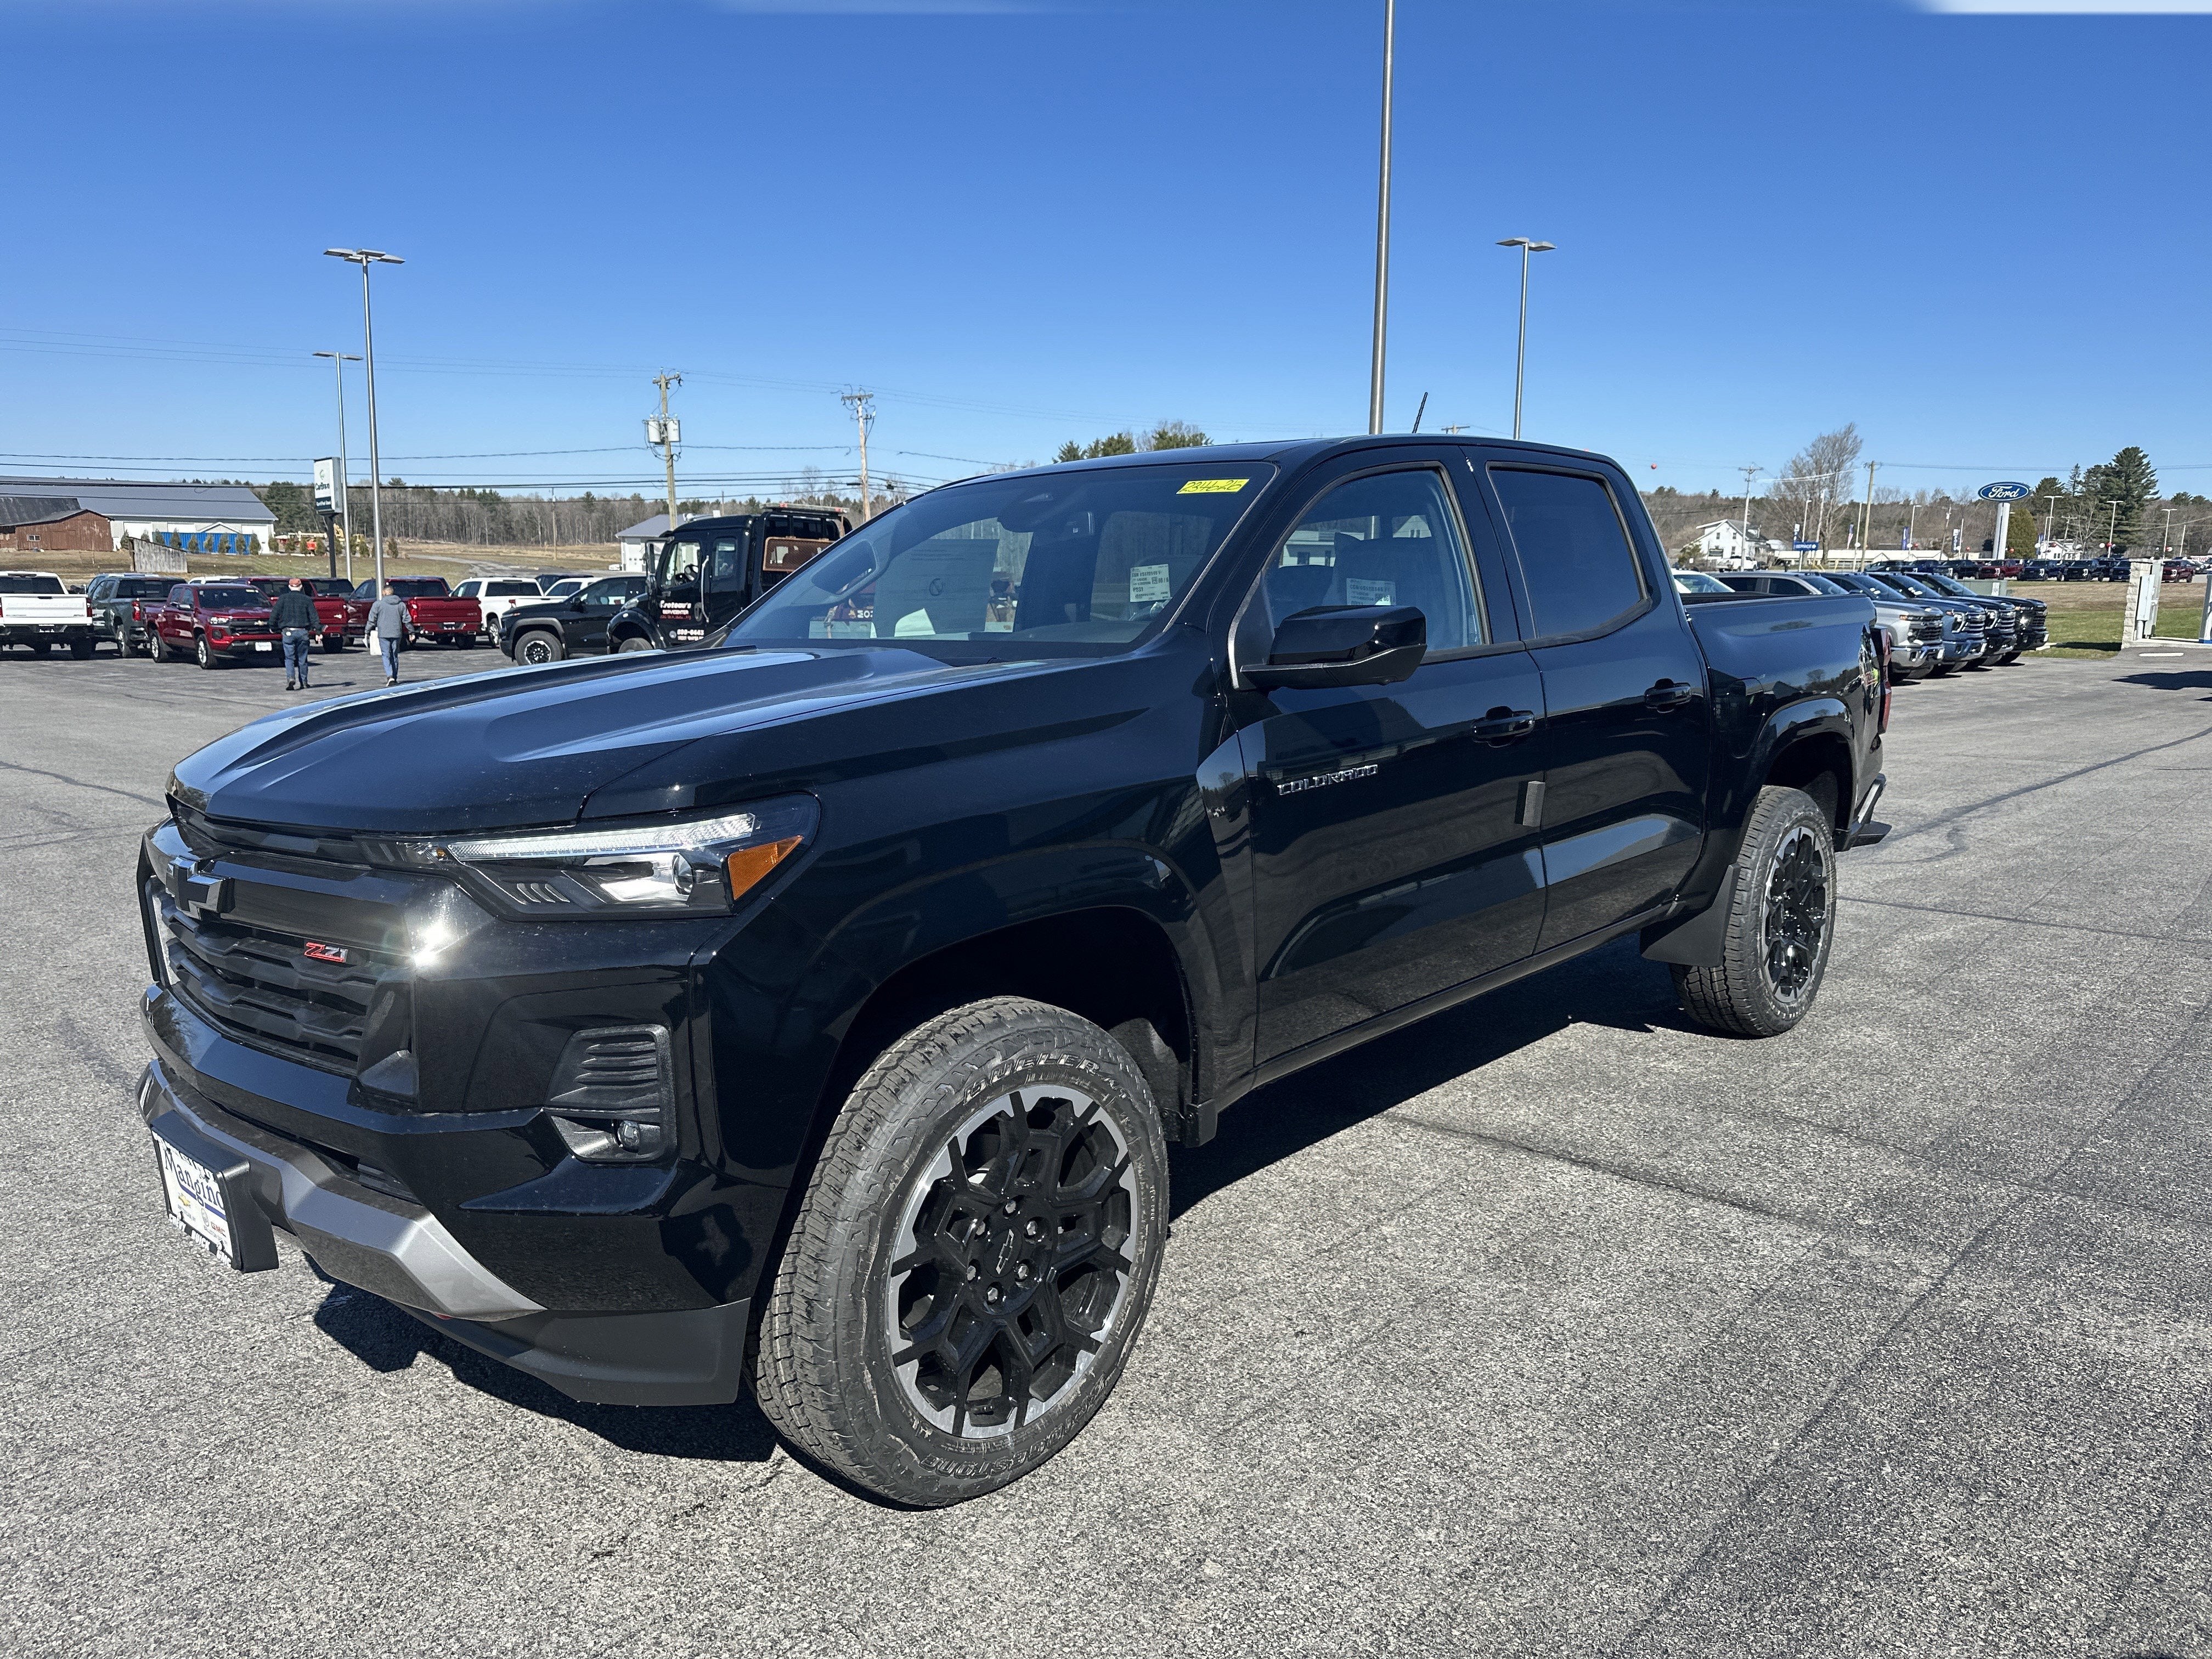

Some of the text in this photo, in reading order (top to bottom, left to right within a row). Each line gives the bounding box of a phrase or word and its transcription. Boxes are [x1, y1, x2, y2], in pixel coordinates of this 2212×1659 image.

[1988, 485, 2021, 498] Ford
[1277, 764, 1378, 795] COLORADO
[304, 942, 348, 963] Z71
[165, 1149, 224, 1211] Mangino
